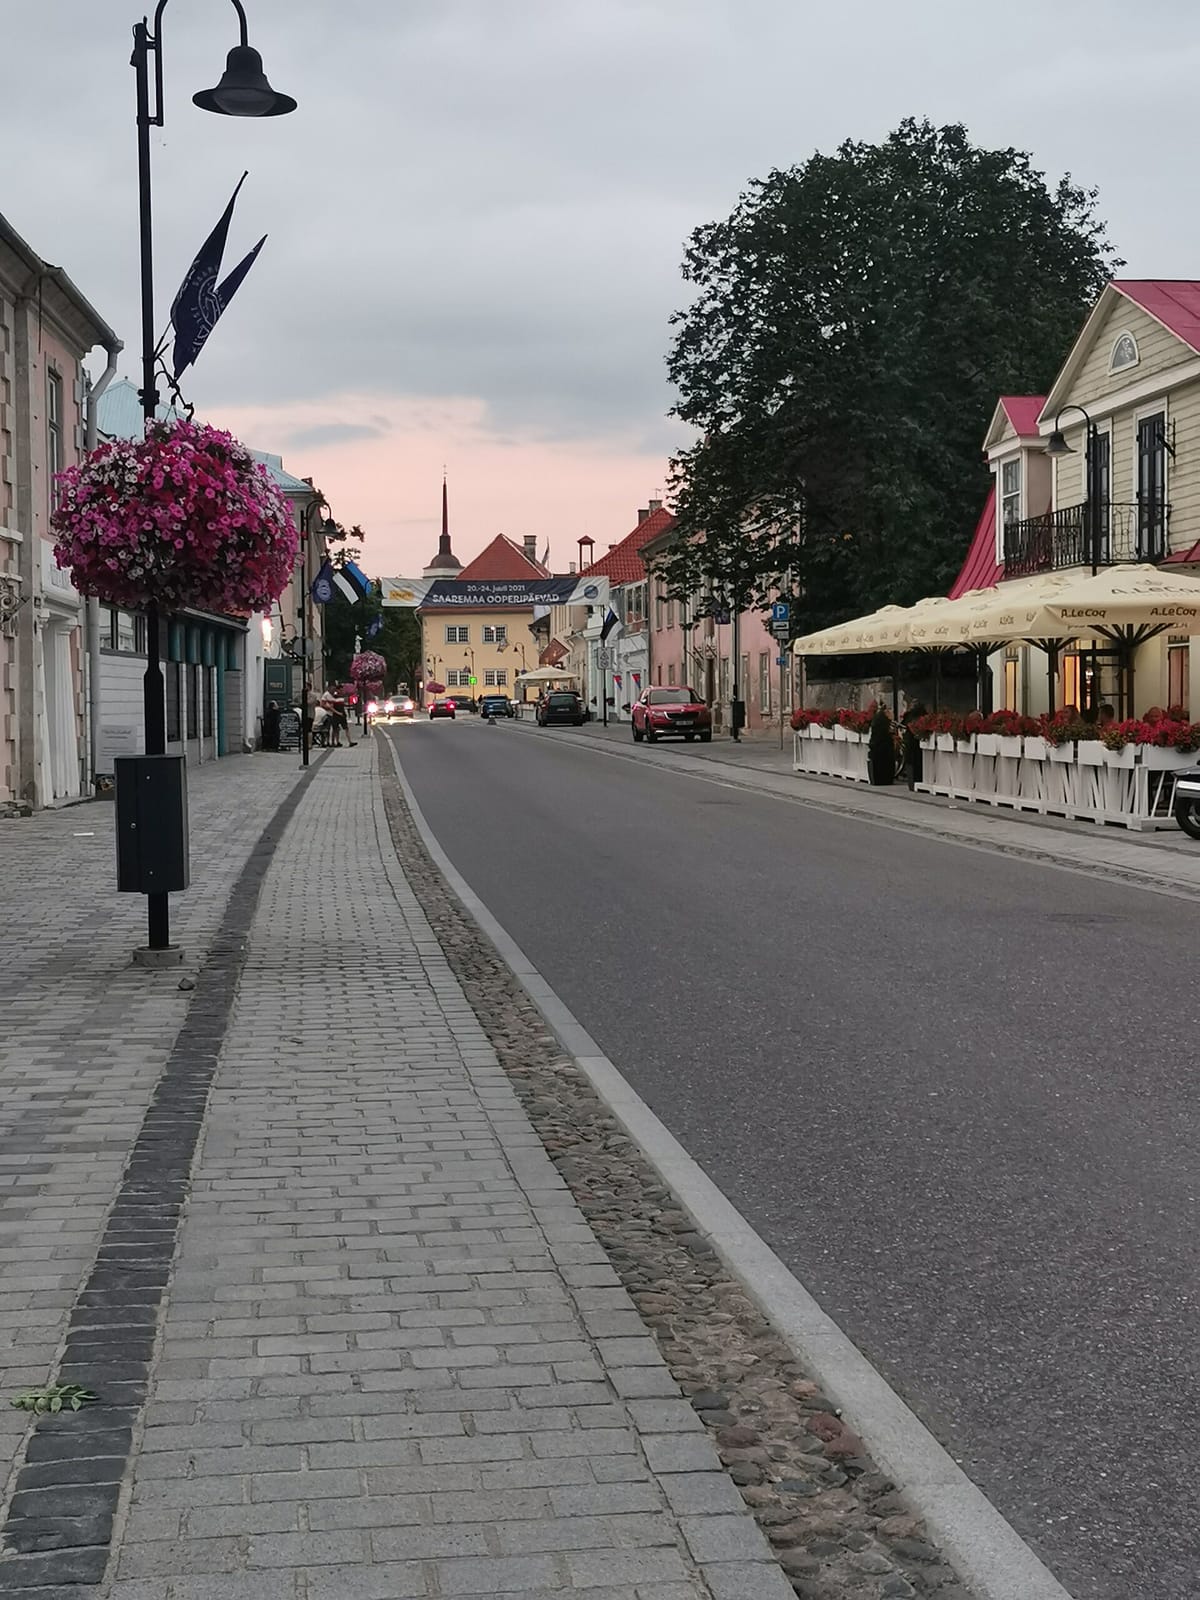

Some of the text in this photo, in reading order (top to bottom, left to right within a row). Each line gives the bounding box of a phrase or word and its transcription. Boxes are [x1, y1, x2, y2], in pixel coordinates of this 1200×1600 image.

[493, 584, 508, 593] juuli
[432, 592, 560, 603] SAAREMAA OOPERIPÄEVAD
[776, 605, 786, 618] P
